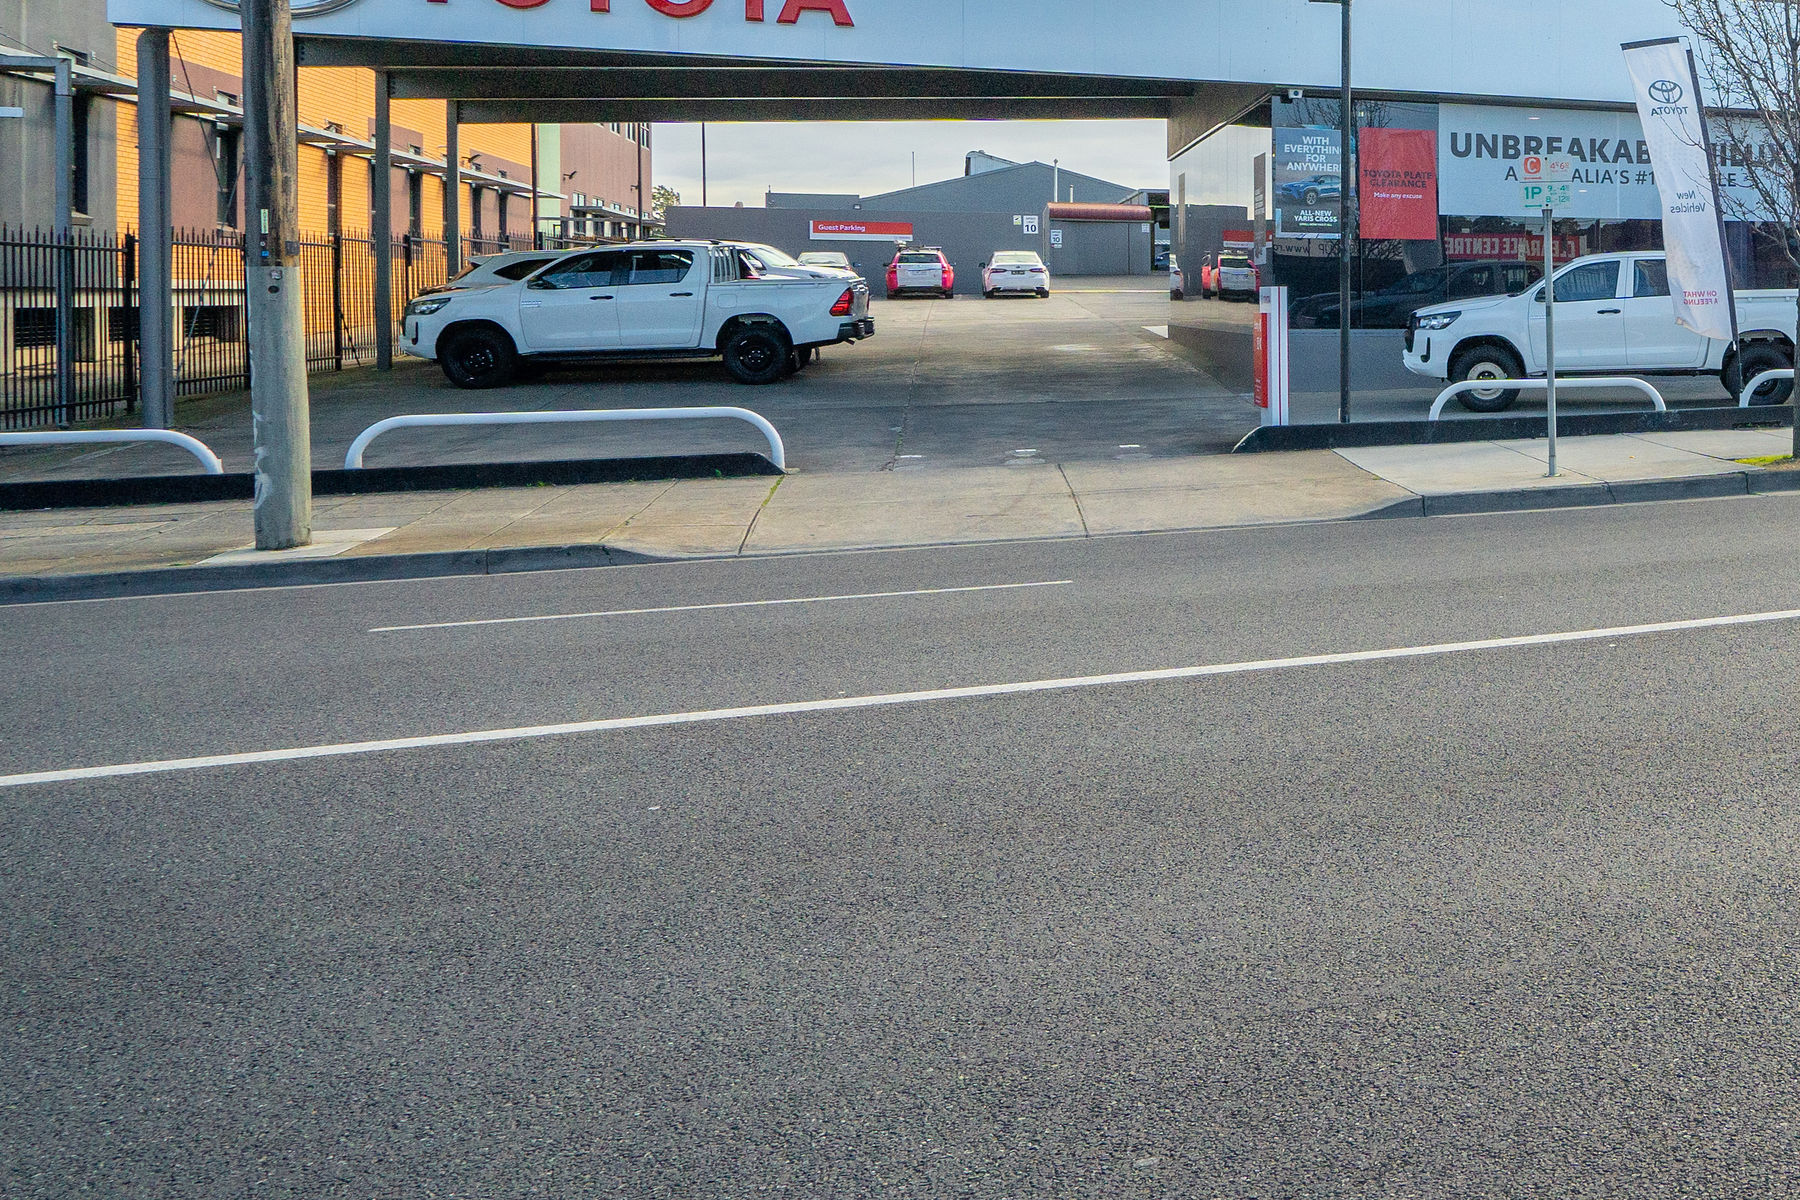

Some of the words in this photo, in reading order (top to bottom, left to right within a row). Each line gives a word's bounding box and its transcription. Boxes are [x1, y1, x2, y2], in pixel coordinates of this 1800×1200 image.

[1302, 136, 1329, 145] WITH
[1284, 144, 1341, 155] EVERYTHIN
[1450, 132, 1652, 164] UNBREAKAB
[1306, 154, 1326, 163] FOR
[1286, 162, 1341, 172] ANYWHER
[1526, 158, 1537, 173] C
[1364, 169, 1401, 178] TOYOTA
[1404, 171, 1433, 179] PLATE
[1370, 180, 1427, 188] CLEARANCE
[1524, 186, 1542, 200] 1P
[1025, 224, 1037, 232] 10
